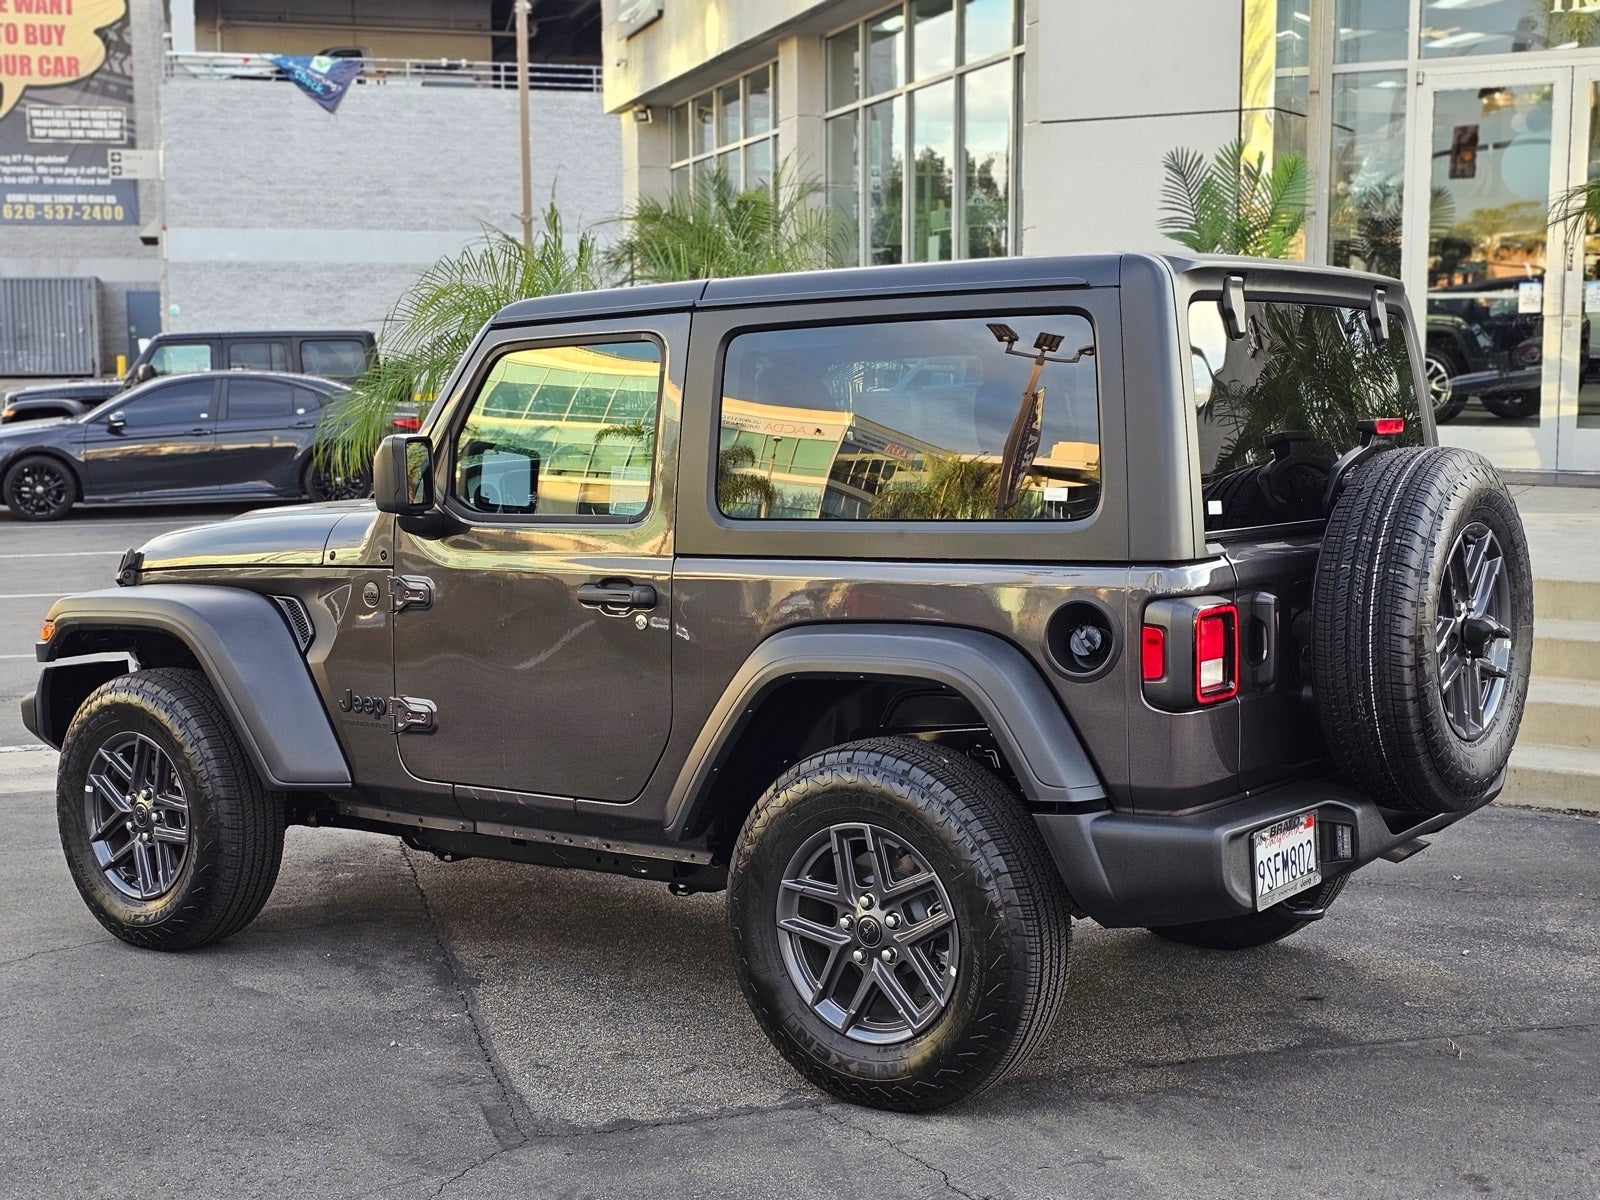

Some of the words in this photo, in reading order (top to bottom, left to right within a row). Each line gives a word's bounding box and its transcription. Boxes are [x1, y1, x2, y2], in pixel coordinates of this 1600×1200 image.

[24, 24, 65, 46] BUY
[38, 55, 80, 77] CAR
[3, 204, 124, 220] 626-537-2400
[339, 689, 387, 720] Jeep
[1258, 839, 1314, 896] 9SFM802
